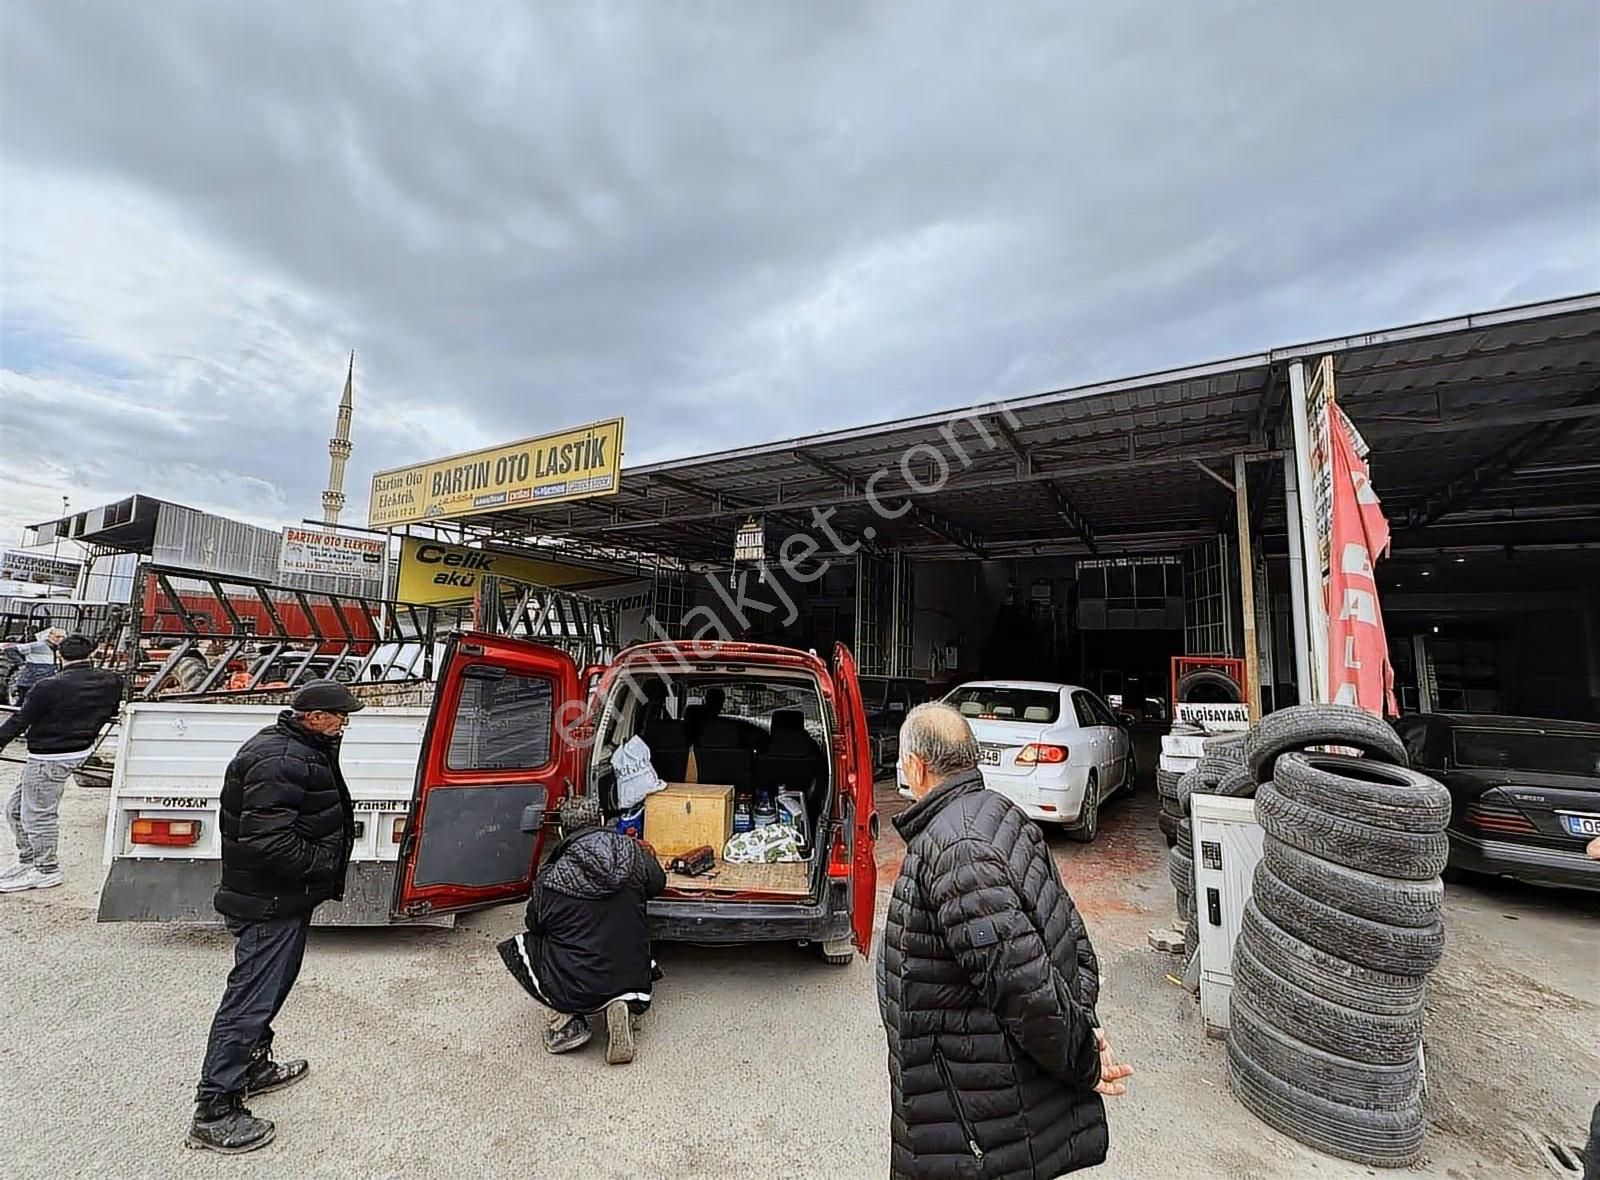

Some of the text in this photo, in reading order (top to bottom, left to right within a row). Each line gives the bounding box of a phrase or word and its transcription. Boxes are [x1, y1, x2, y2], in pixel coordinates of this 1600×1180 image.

[431, 461, 490, 497] BARTIN
[495, 452, 530, 486] OTO
[535, 433, 608, 479] LASTİK
[406, 471, 423, 486] Oto
[287, 530, 322, 545] BARTIN
[324, 536, 341, 547] OTO
[433, 571, 477, 588] akü
[1180, 706, 1248, 722] BİLGİSAYARL
[163, 797, 208, 808] OTOSAN
